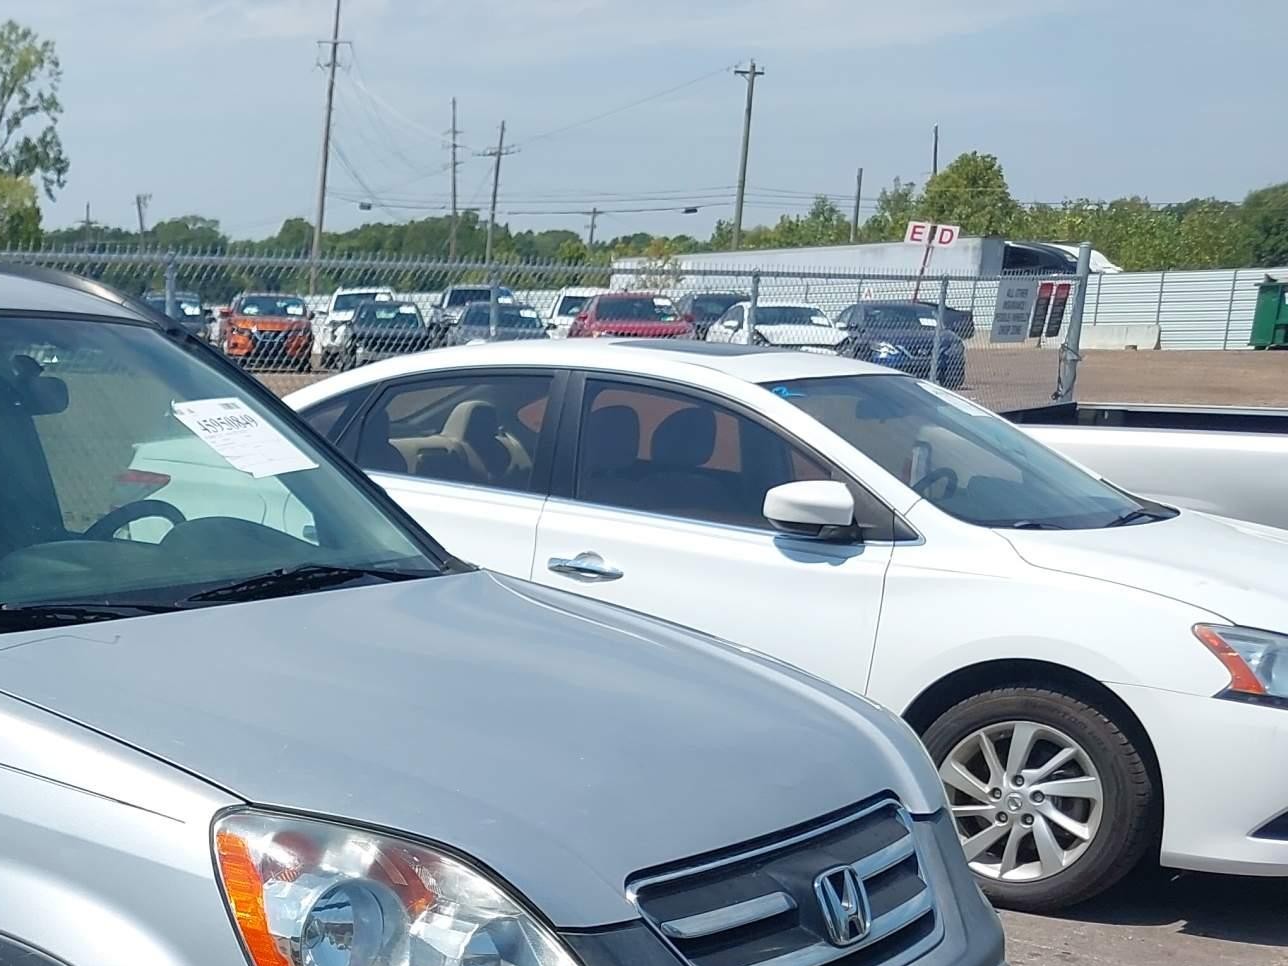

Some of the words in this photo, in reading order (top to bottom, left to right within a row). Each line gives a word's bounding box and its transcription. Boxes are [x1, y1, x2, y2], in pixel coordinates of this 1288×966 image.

[910, 225, 926, 242] E
[938, 228, 954, 245] D
[197, 414, 258, 434] 45950849
